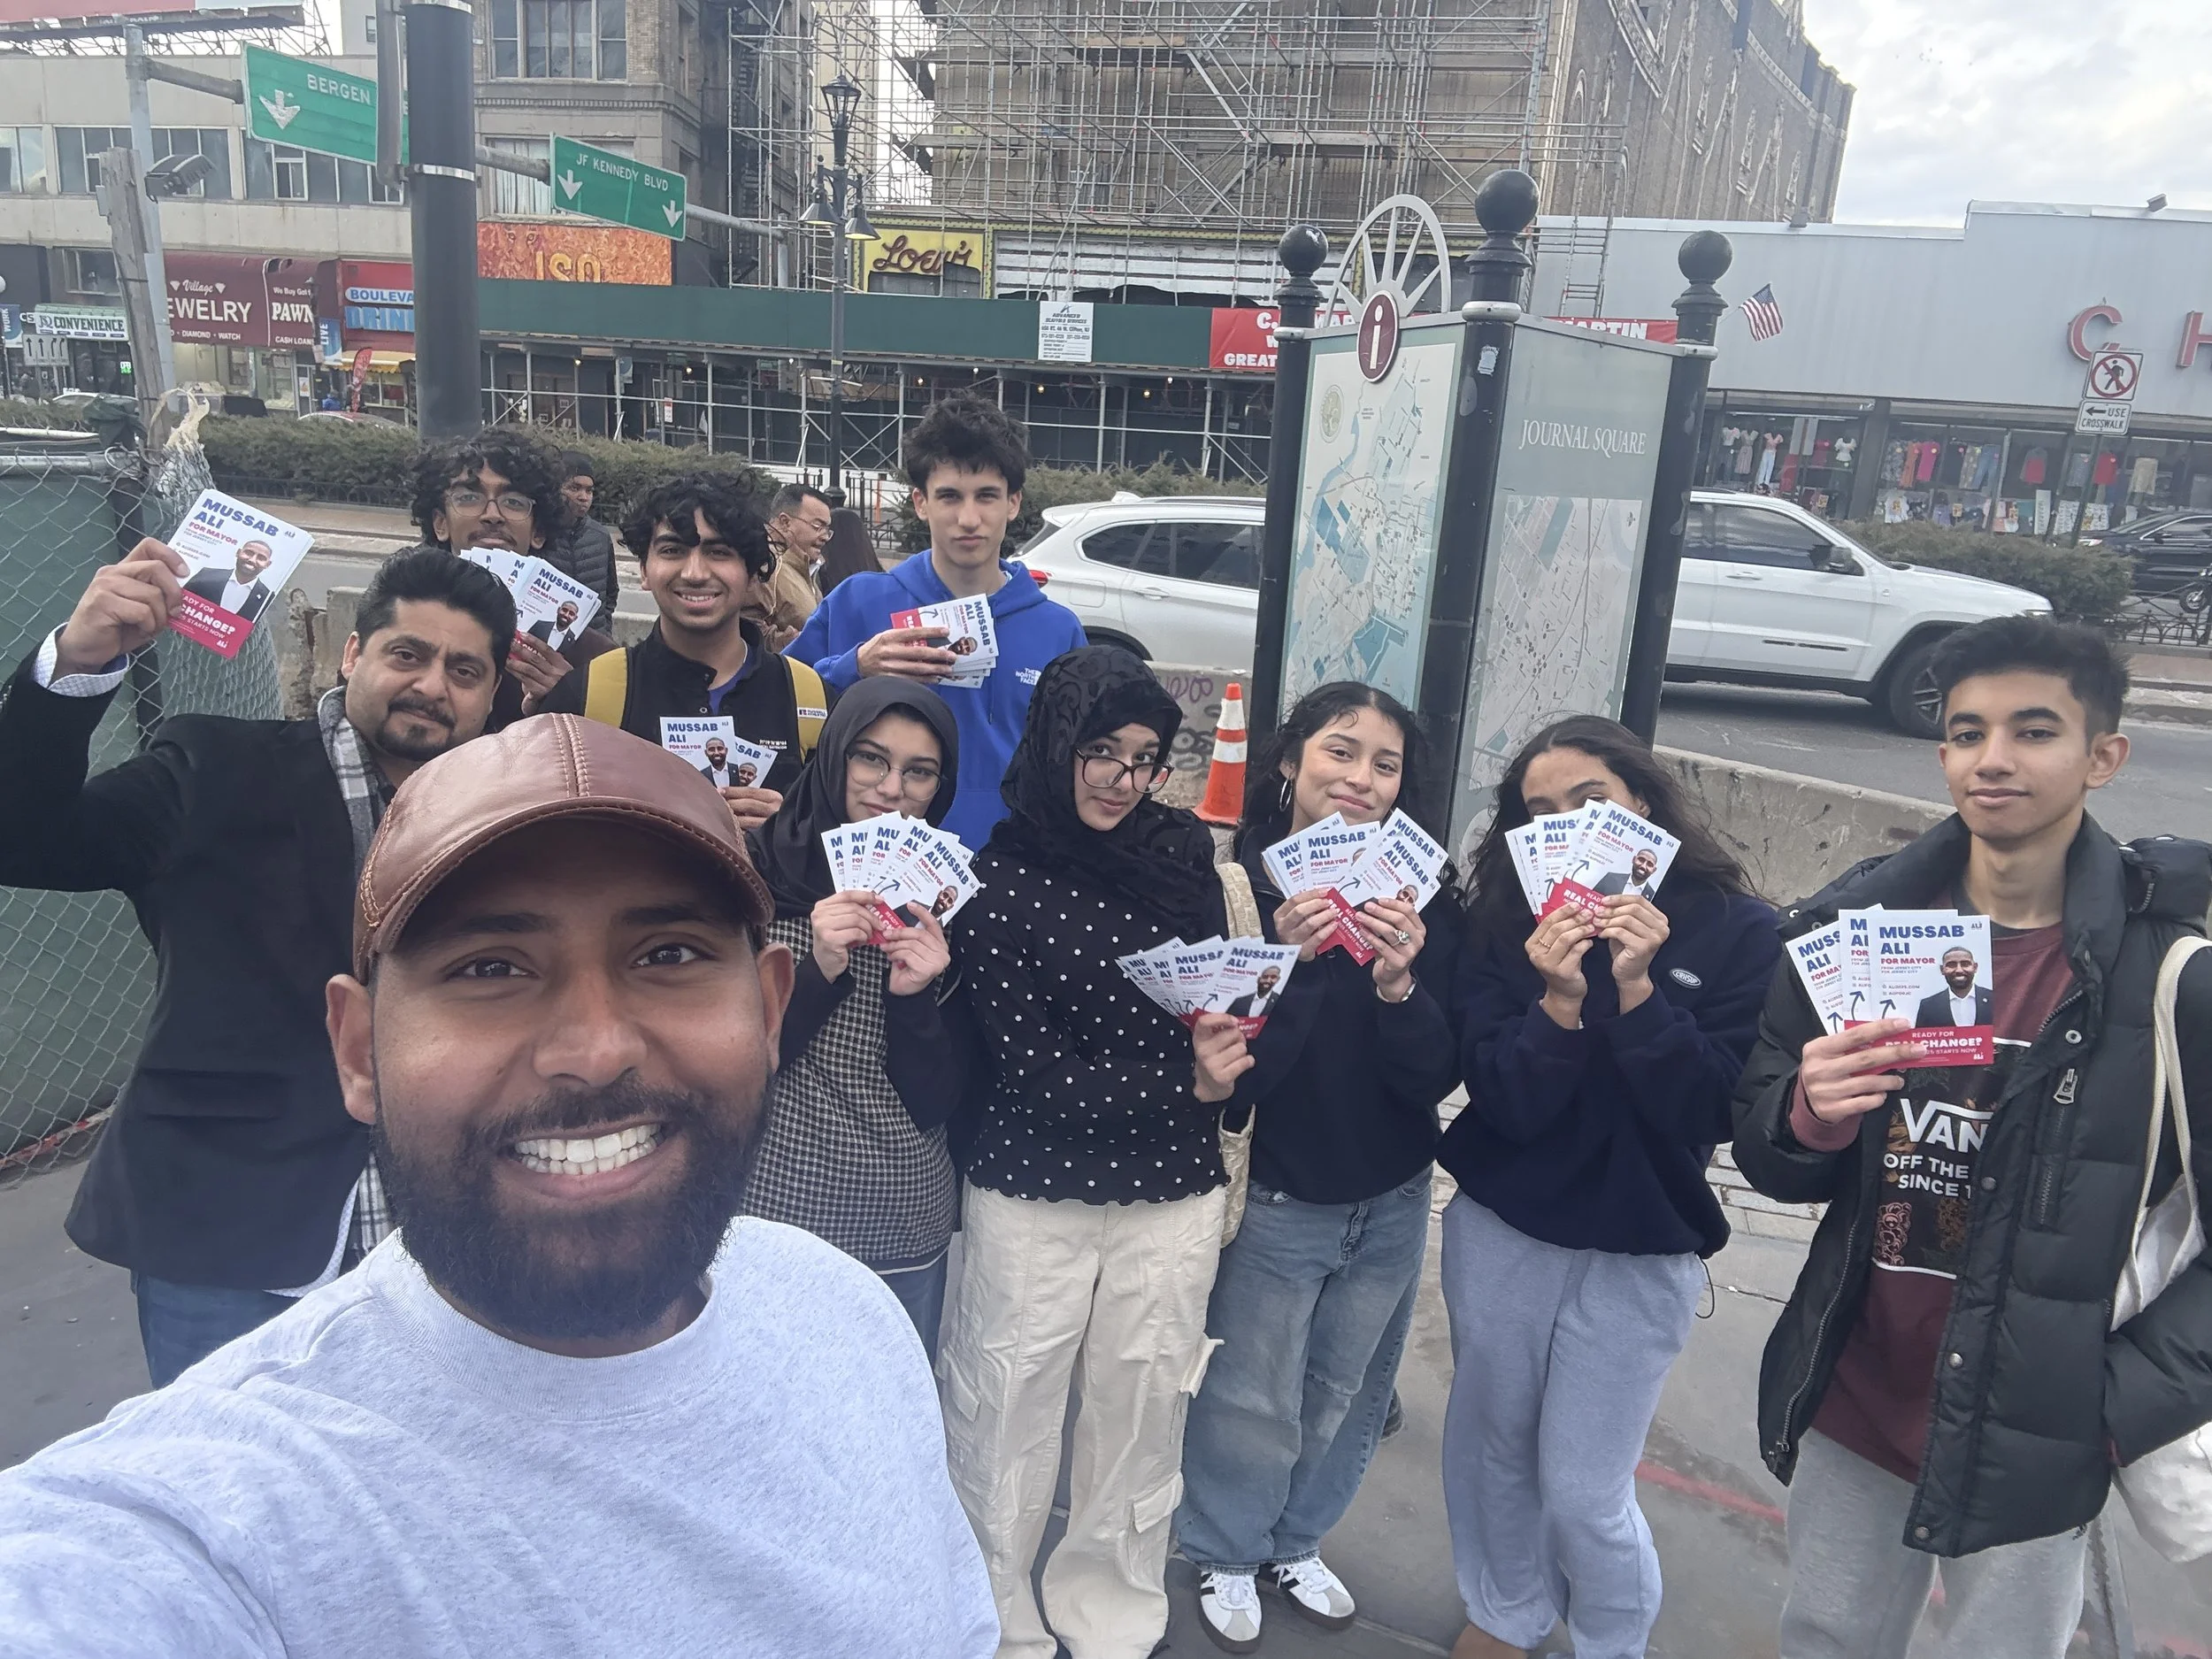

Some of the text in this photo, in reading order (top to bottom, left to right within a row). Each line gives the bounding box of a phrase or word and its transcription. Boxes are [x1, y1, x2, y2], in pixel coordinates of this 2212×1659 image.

[307, 73, 371, 105] BERGEN
[577, 153, 669, 191] JF KENNEDY BLVD
[182, 279, 213, 296] Village
[2, 308, 12, 333] WORK
[54, 316, 125, 332] CONVENIENCE
[181, 330, 211, 339] DIAMOND
[218, 332, 242, 341] WATCH
[319, 323, 330, 346] LIVE
[1224, 353, 1279, 367] GREAT
[2108, 408, 2126, 419] USE
[2081, 418, 2124, 430] CROSSWALK
[1518, 419, 1647, 459] JOURNAL SQUARE
[193, 511, 226, 530] ALI
[203, 497, 280, 537] MUSSAB
[188, 521, 207, 533] FOR
[205, 528, 239, 546] MAYOR
[533, 577, 552, 593] ALI
[538, 567, 584, 599] MUSSAB
[198, 602, 215, 615] FOR
[964, 603, 975, 620] ALI
[187, 618, 226, 640] STARTS NOW
[973, 601, 991, 646] MUSSAB
[1015, 671, 1035, 680] NORTH
[667, 722, 718, 733] MUSSAB
[668, 733, 687, 743] ALI
[1601, 821, 1625, 838] ALI
[1608, 810, 1663, 846] MUSSAB
[1308, 831, 1366, 848] MUSSAB
[1394, 818, 1436, 858] MUSSAB
[1544, 833, 1567, 843] ALI
[1597, 831, 1611, 841] FOR
[1610, 837, 1634, 853] MAYOR
[898, 847, 912, 857] FOR
[924, 850, 943, 871] ALI
[1310, 848, 1331, 860] ALI
[1384, 849, 1402, 869] ALI
[933, 841, 970, 886] MUSSAB
[1324, 857, 1348, 866] MAYOR
[1393, 841, 1430, 886] MUSSAB
[1379, 856, 1403, 886] FOR MAYOR
[1563, 888, 1586, 906] REAL
[1878, 925, 1965, 941] MUSSAB
[1231, 947, 1286, 961] MUSSAB
[1880, 942, 1910, 955] ALI
[1178, 964, 1200, 974] ALI
[1226, 957, 1248, 968] ALI
[1806, 953, 1832, 972] ALI
[1810, 972, 1827, 982] FOR
[1919, 1037, 1983, 1048] CHANGE?
[1883, 1152, 1970, 1179] OFF THE
[1897, 1173, 1959, 1197] SINCE
